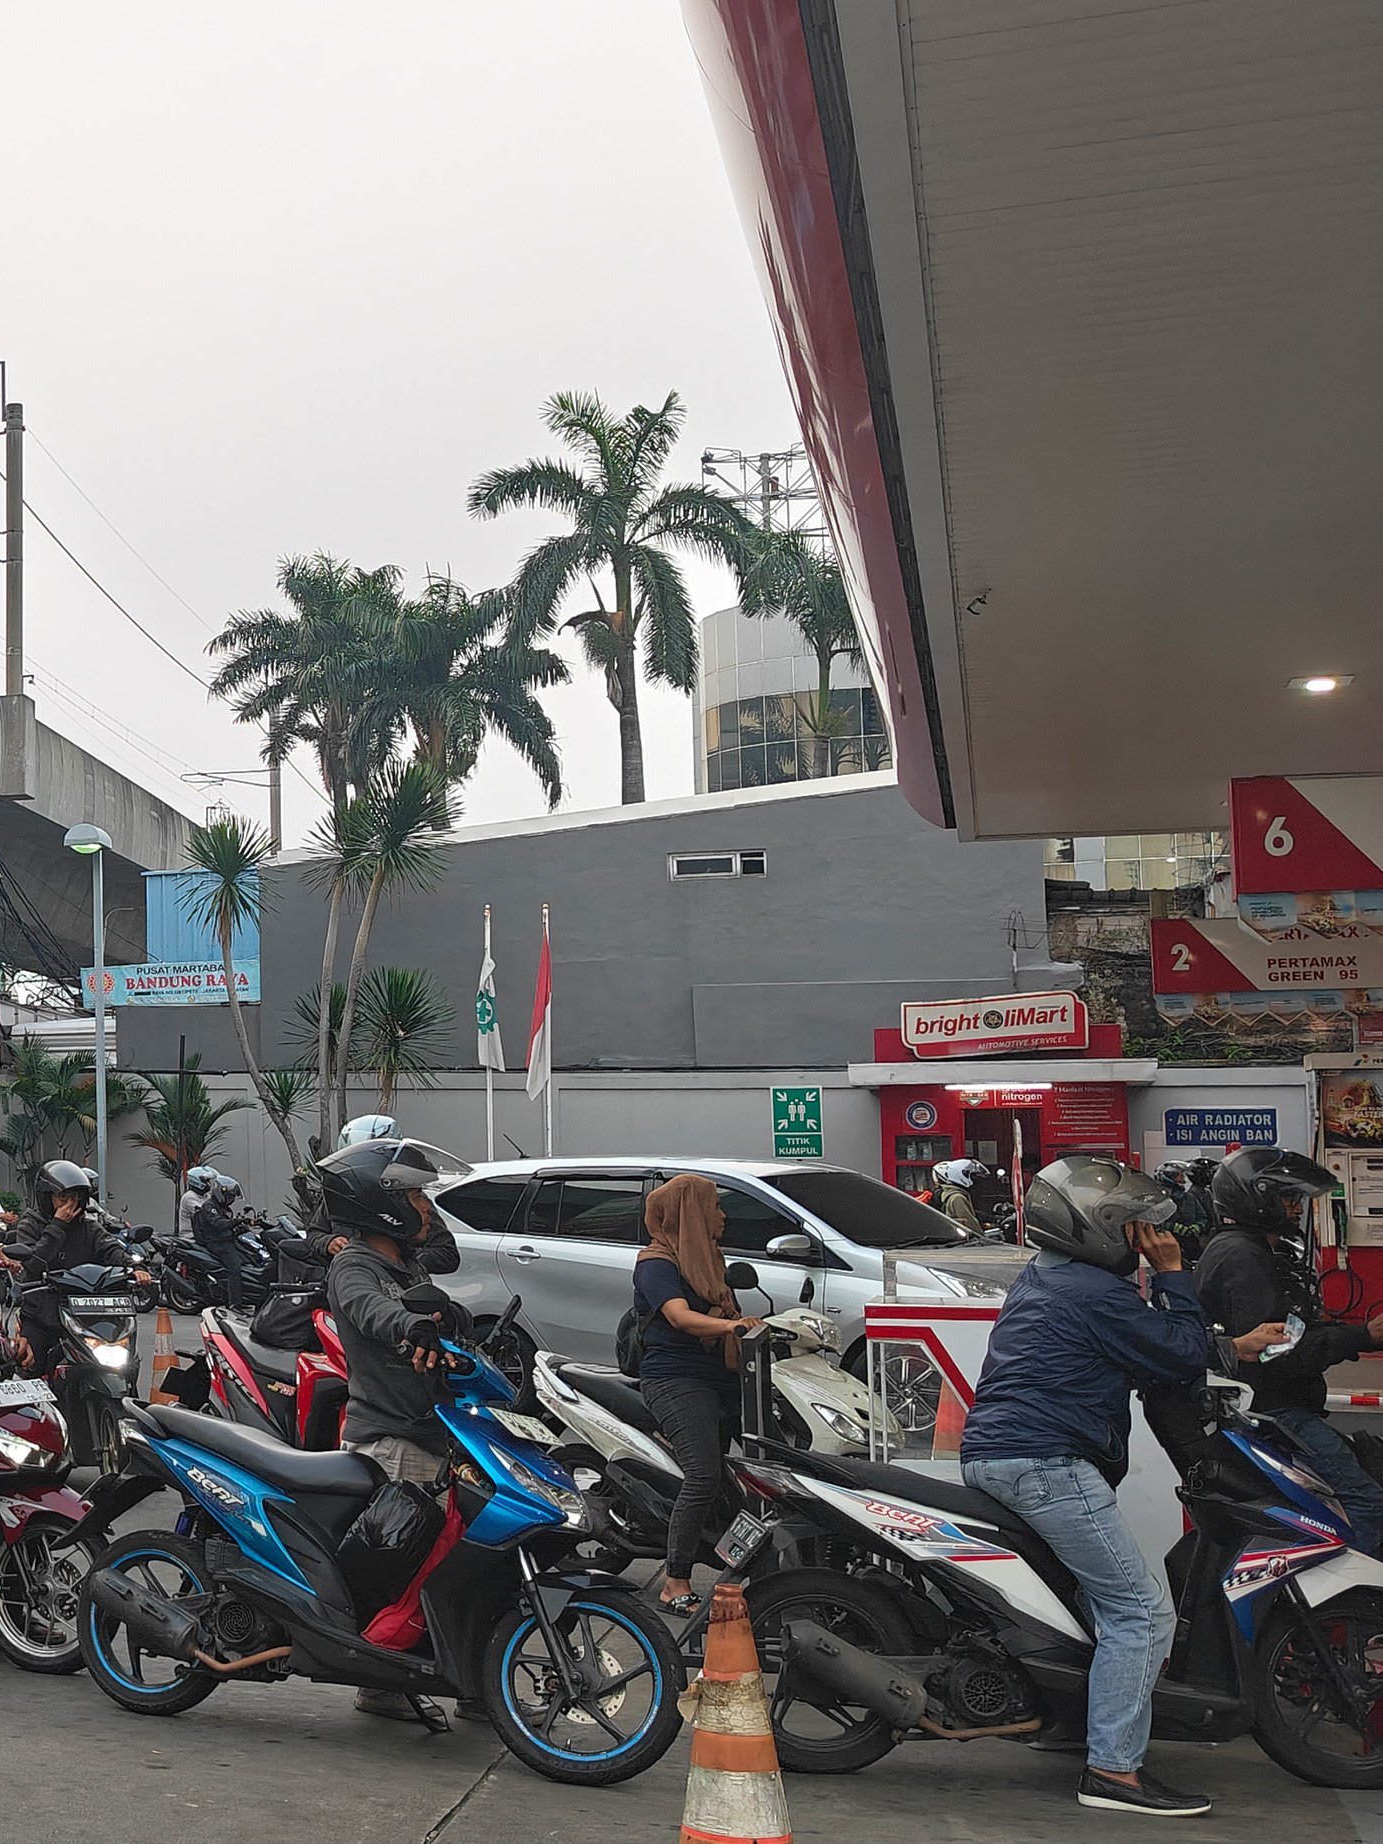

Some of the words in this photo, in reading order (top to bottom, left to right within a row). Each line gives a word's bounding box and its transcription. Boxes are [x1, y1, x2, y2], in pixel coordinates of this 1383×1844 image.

[1264, 816, 1294, 857] 6
[1171, 943, 1191, 971] 2
[1268, 956, 1357, 969] PERTAMAX
[136, 966, 169, 975] PUSAT
[173, 964, 225, 974] MARTABA
[1268, 970, 1324, 983] GREEN
[1339, 969, 1359, 981] 95
[126, 975, 202, 990] BANDUNG
[915, 1013, 981, 1037] bright
[978, 1038, 1029, 1050] AUTOMOTIVE
[1030, 1035, 1068, 1046] SERVICES
[1002, 1092, 1043, 1102] nitrogen
[1177, 1114, 1199, 1126] AIR
[1205, 1114, 1272, 1126] RADIATOR
[786, 1137, 810, 1145] TITIK
[1177, 1129, 1192, 1141] ISI
[1200, 1129, 1240, 1141] ANGIN
[1246, 1129, 1273, 1141] BAN
[778, 1147, 818, 1155] KUMPUL
[1300, 1515, 1337, 1535] HONDA
